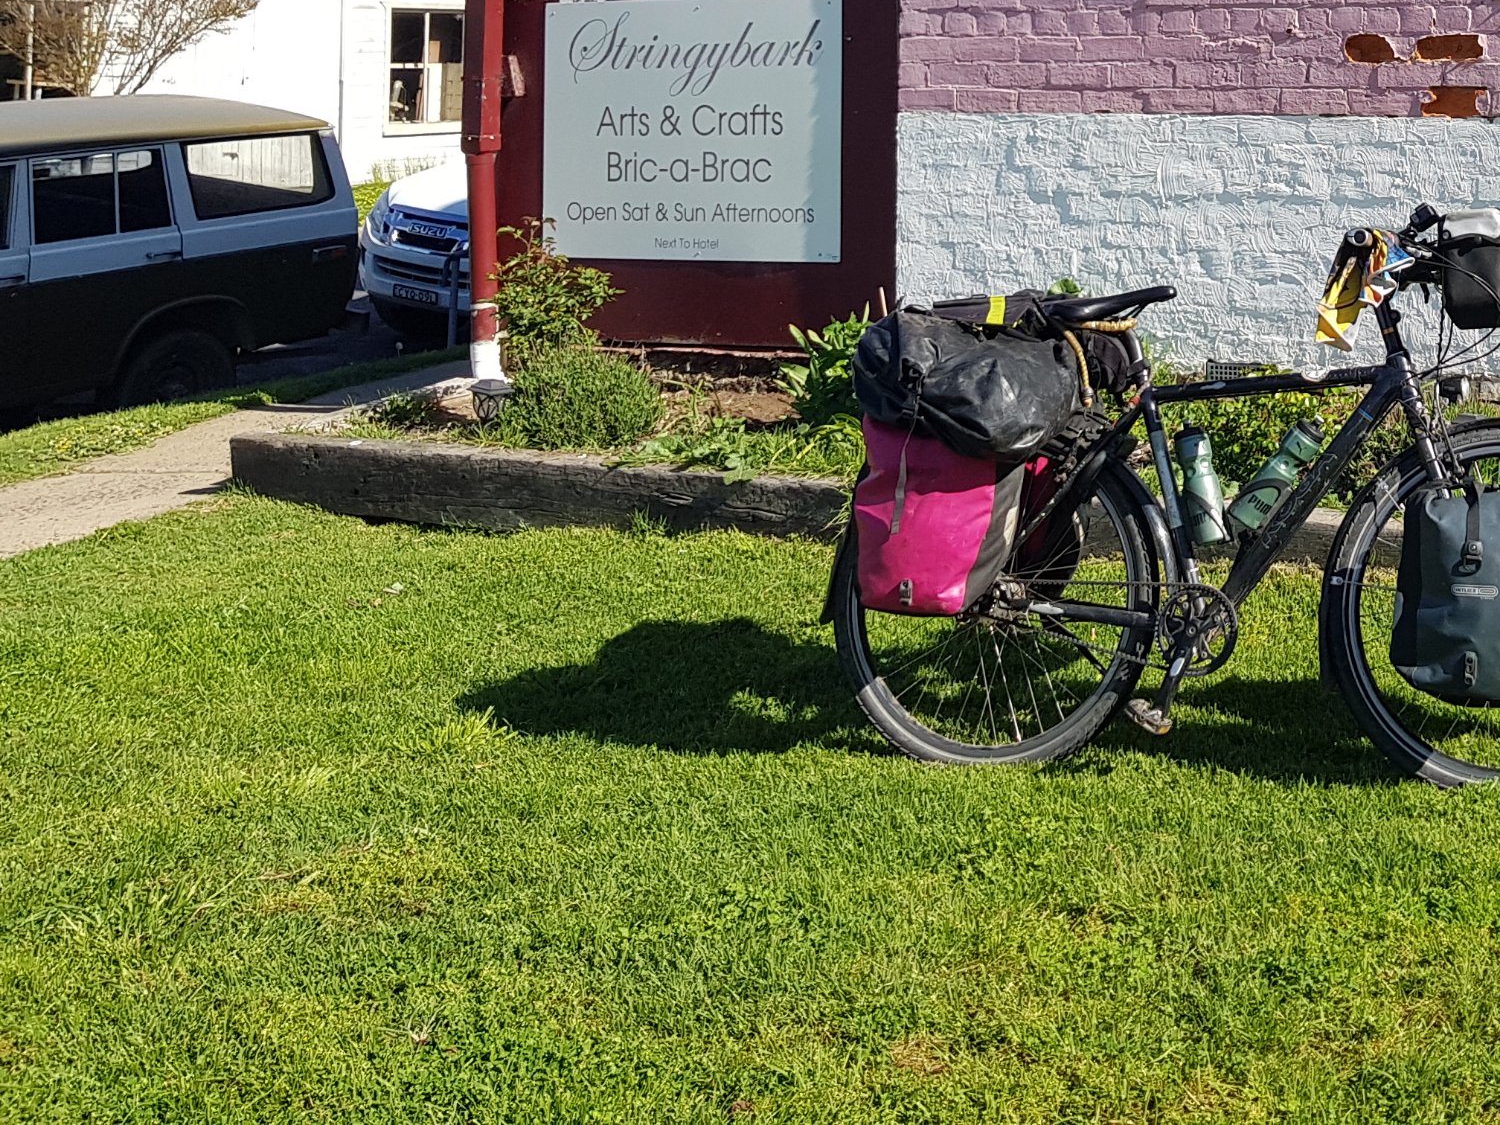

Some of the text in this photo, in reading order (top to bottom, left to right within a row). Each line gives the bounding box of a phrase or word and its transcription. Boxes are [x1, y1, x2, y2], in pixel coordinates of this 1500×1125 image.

[568, 11, 824, 97] Stringybark
[596, 103, 784, 137] Arts & Crafts
[606, 151, 773, 183] Bric-a-Brac
[566, 201, 815, 225] Open Sat & Sun Afternoons
[408, 223, 447, 238] ISUZU
[654, 237, 719, 250] Next To Hotel
[1247, 493, 1273, 516] PUM
